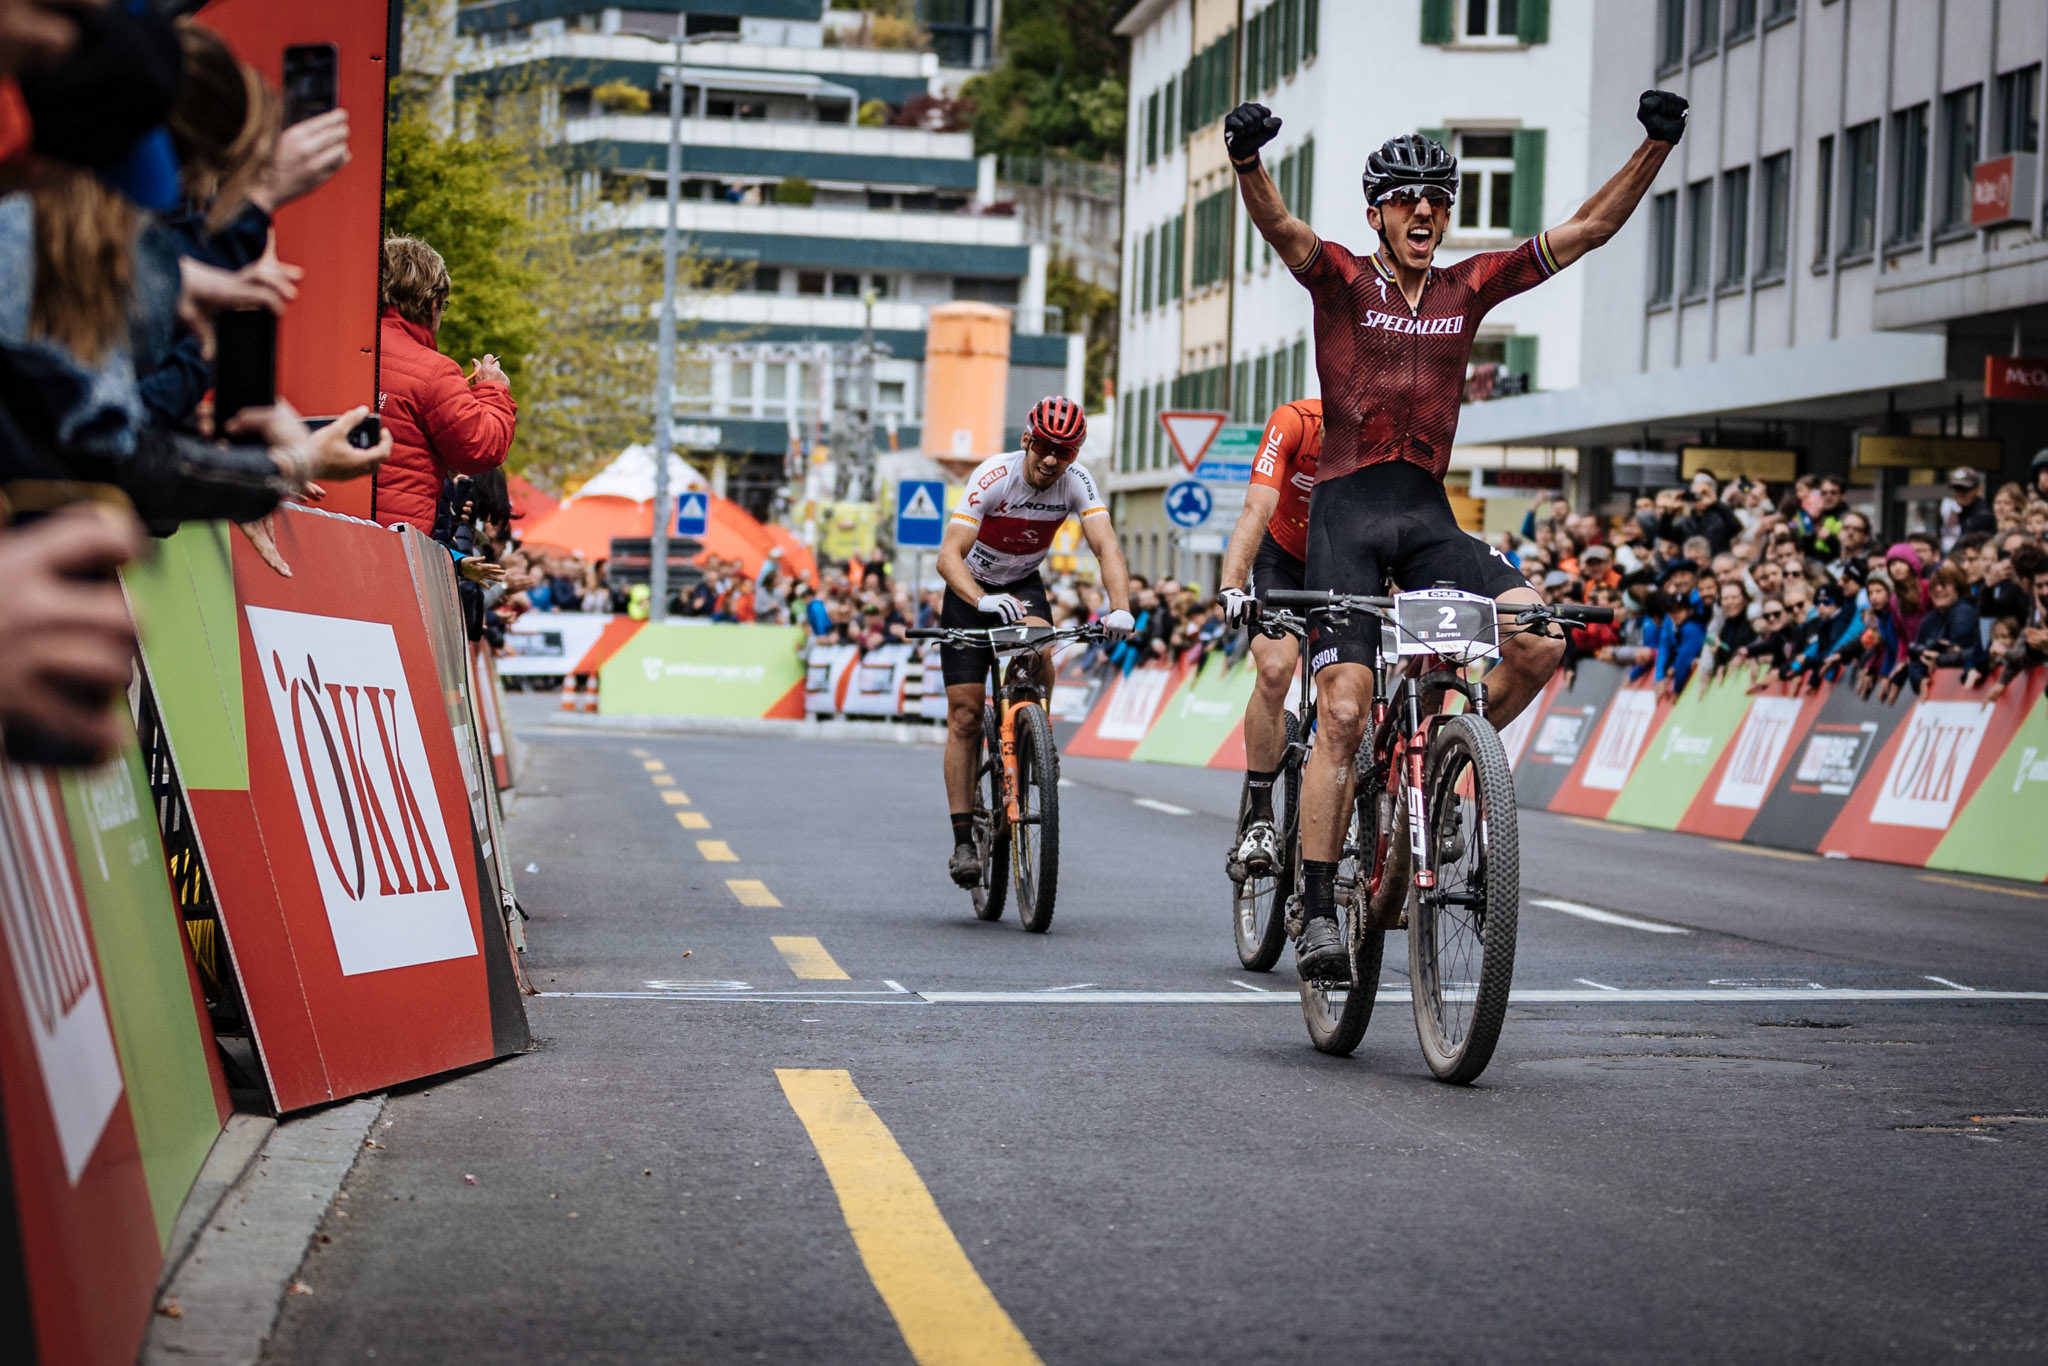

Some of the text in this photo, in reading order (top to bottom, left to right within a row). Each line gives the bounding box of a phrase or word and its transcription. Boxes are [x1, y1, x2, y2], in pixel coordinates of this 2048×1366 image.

[1360, 309, 1464, 335] SPECIALIZED
[1255, 425, 1283, 477] BMC
[979, 467, 1007, 489] ORLEN
[1068, 466, 1096, 500] KROSS
[1010, 502, 1068, 512] KROSS
[1437, 606, 1458, 629] 2
[1015, 627, 1029, 640] 7
[1436, 631, 1461, 639] Sarrou
[1892, 716, 1976, 802] ÖKK
[272, 649, 450, 902] ÖKK
[1407, 785, 1427, 858] SID
